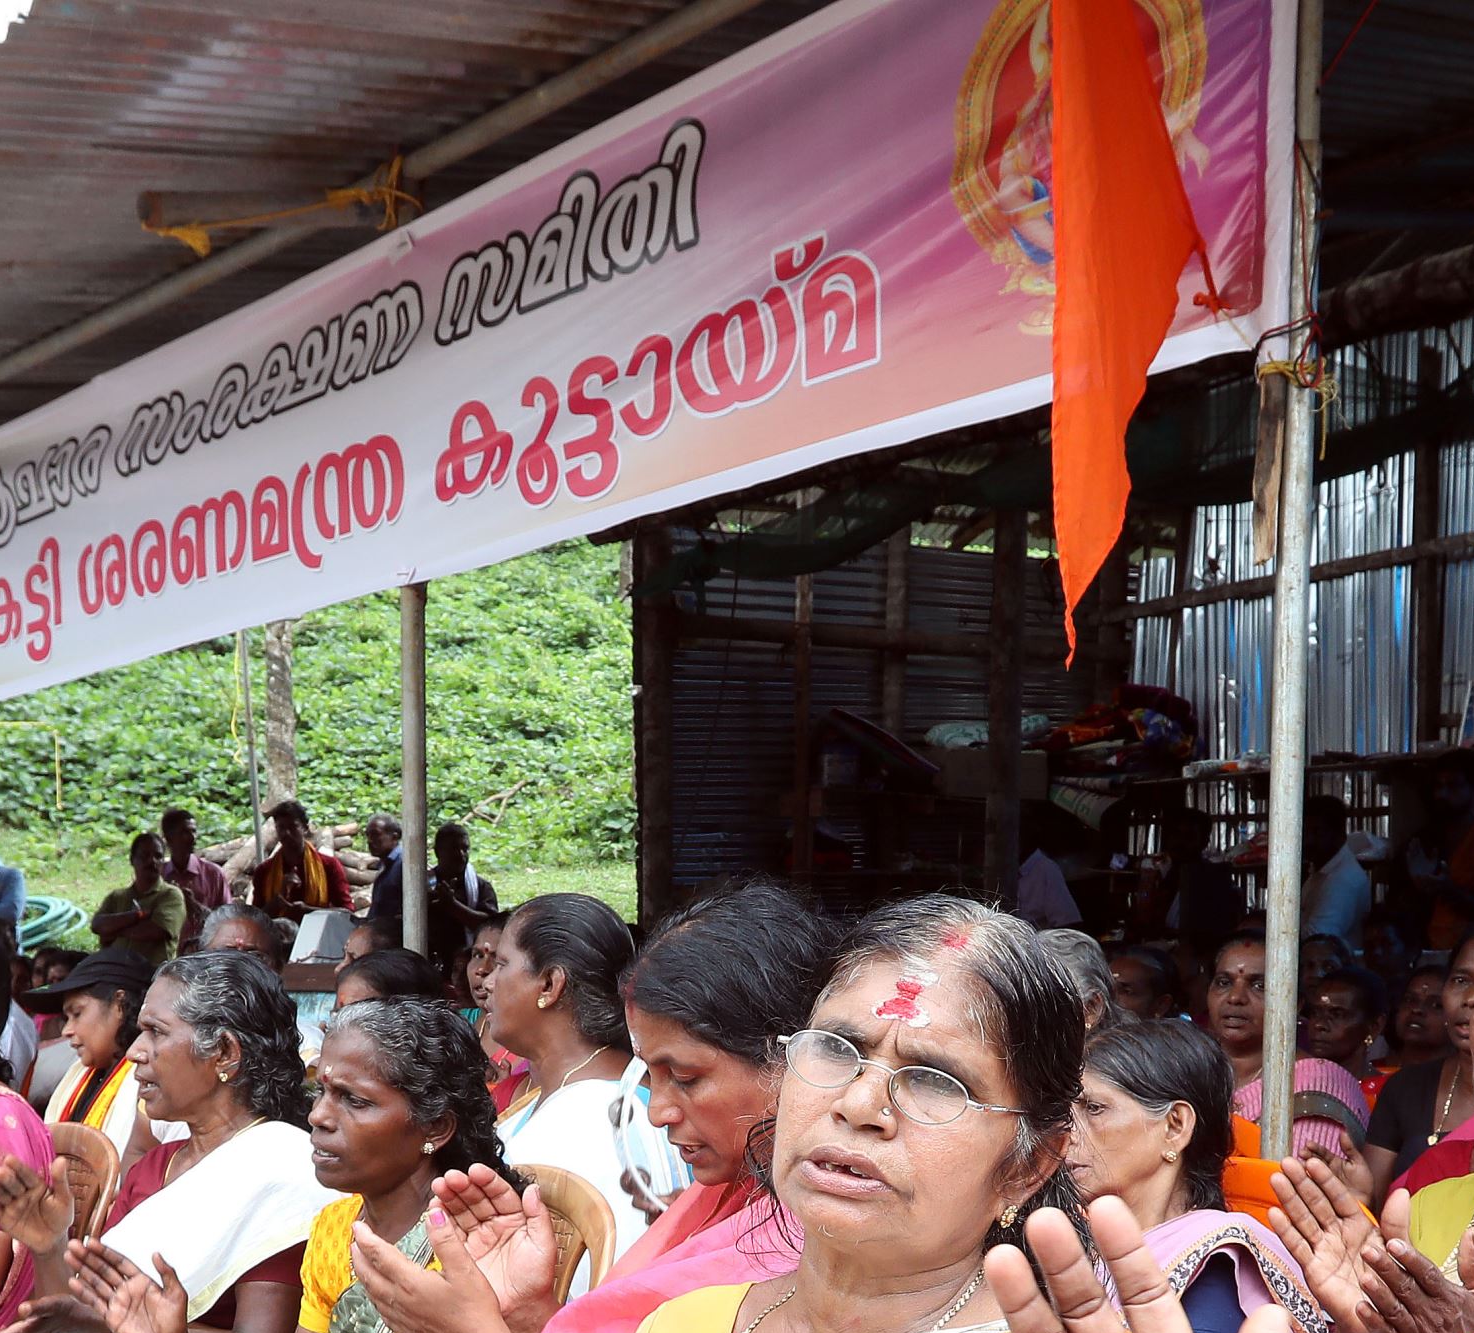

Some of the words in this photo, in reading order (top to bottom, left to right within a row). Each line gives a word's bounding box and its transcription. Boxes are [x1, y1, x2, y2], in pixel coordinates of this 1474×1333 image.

[78, 434, 404, 615] ശരണമന്ത്ര
[435, 232, 880, 506] കൂട്ടായ്മ
[115, 280, 424, 477] സംരക്ഷണ
[434, 116, 706, 346] സമിതി
